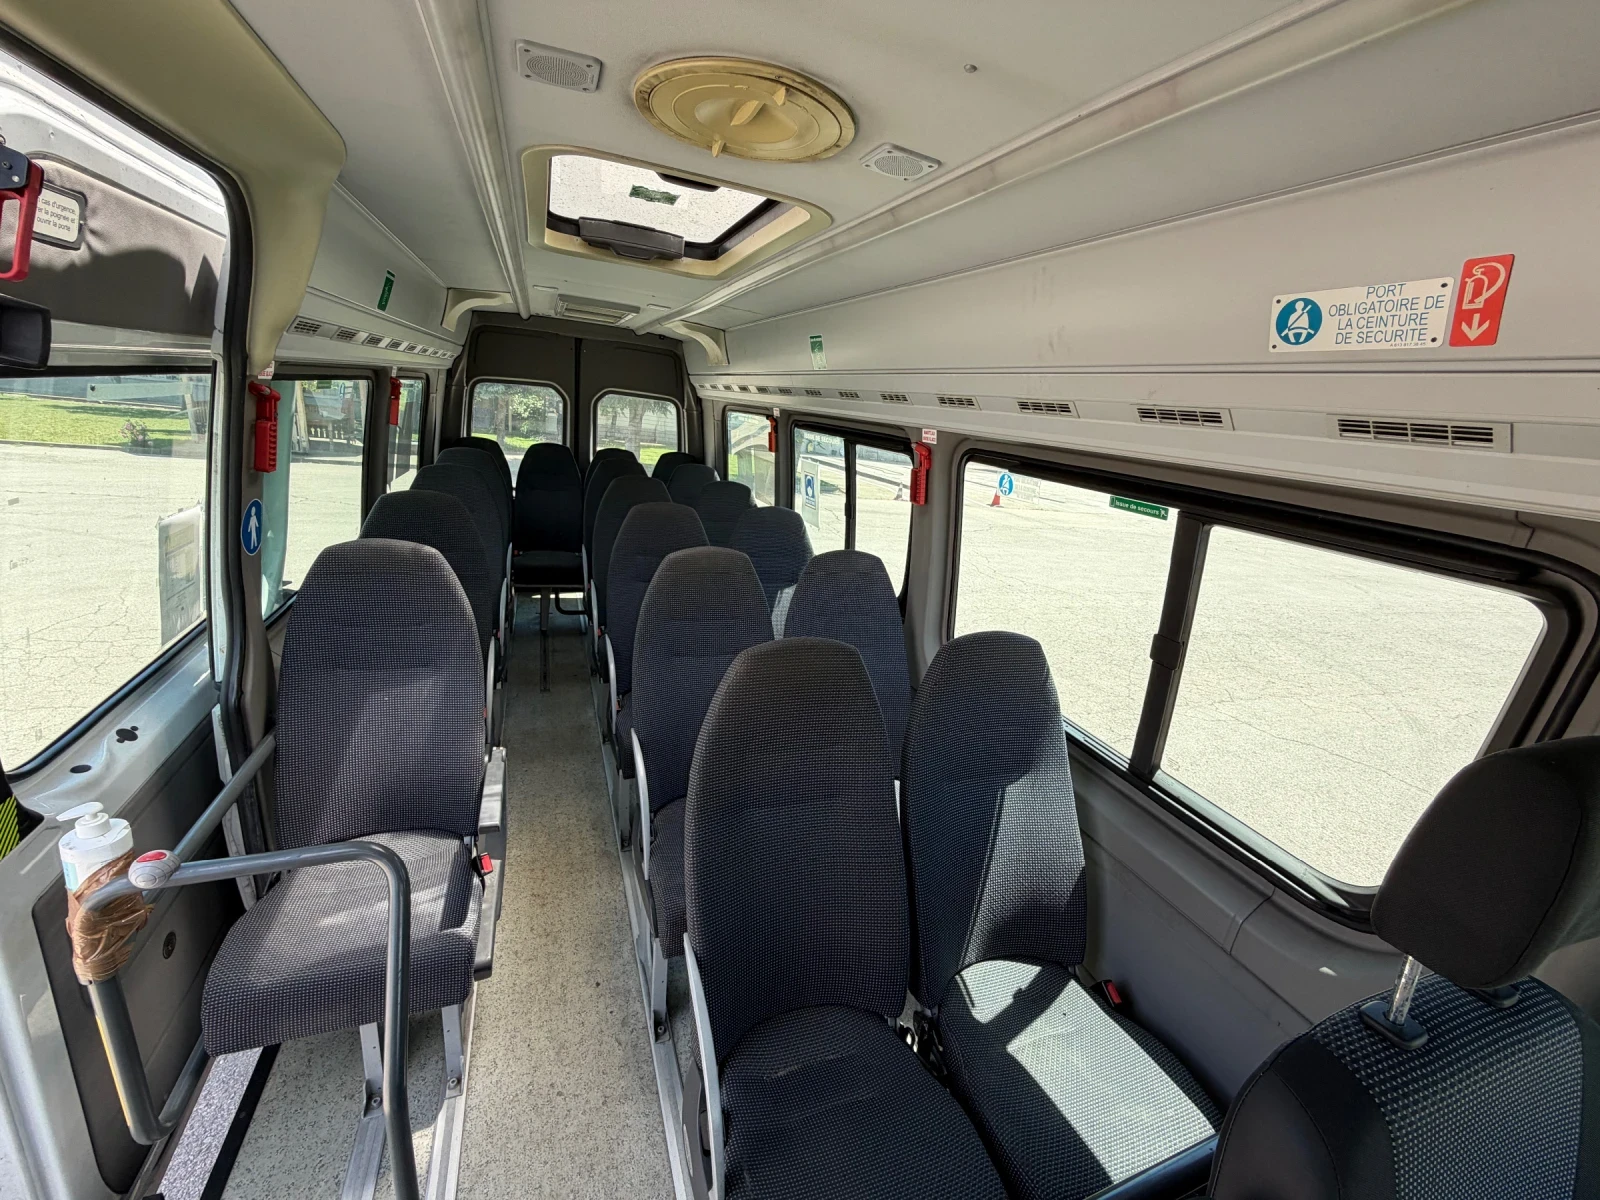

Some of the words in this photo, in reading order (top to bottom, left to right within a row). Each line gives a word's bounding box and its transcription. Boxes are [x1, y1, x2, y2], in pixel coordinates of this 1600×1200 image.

[44, 208, 49, 216] la
[37, 216, 52, 225] ouvrir
[58, 224, 71, 232] porte
[1366, 283, 1406, 299] PORT
[1328, 296, 1420, 317] OBLIGATOIRE
[1424, 295, 1446, 310] DE
[1337, 318, 1353, 330] LA
[1356, 312, 1430, 329] CEINTURE
[1335, 332, 1353, 344] DE
[1356, 328, 1428, 344] SECURITE
[1115, 500, 1129, 508] Issue
[1138, 506, 1159, 515] secours
